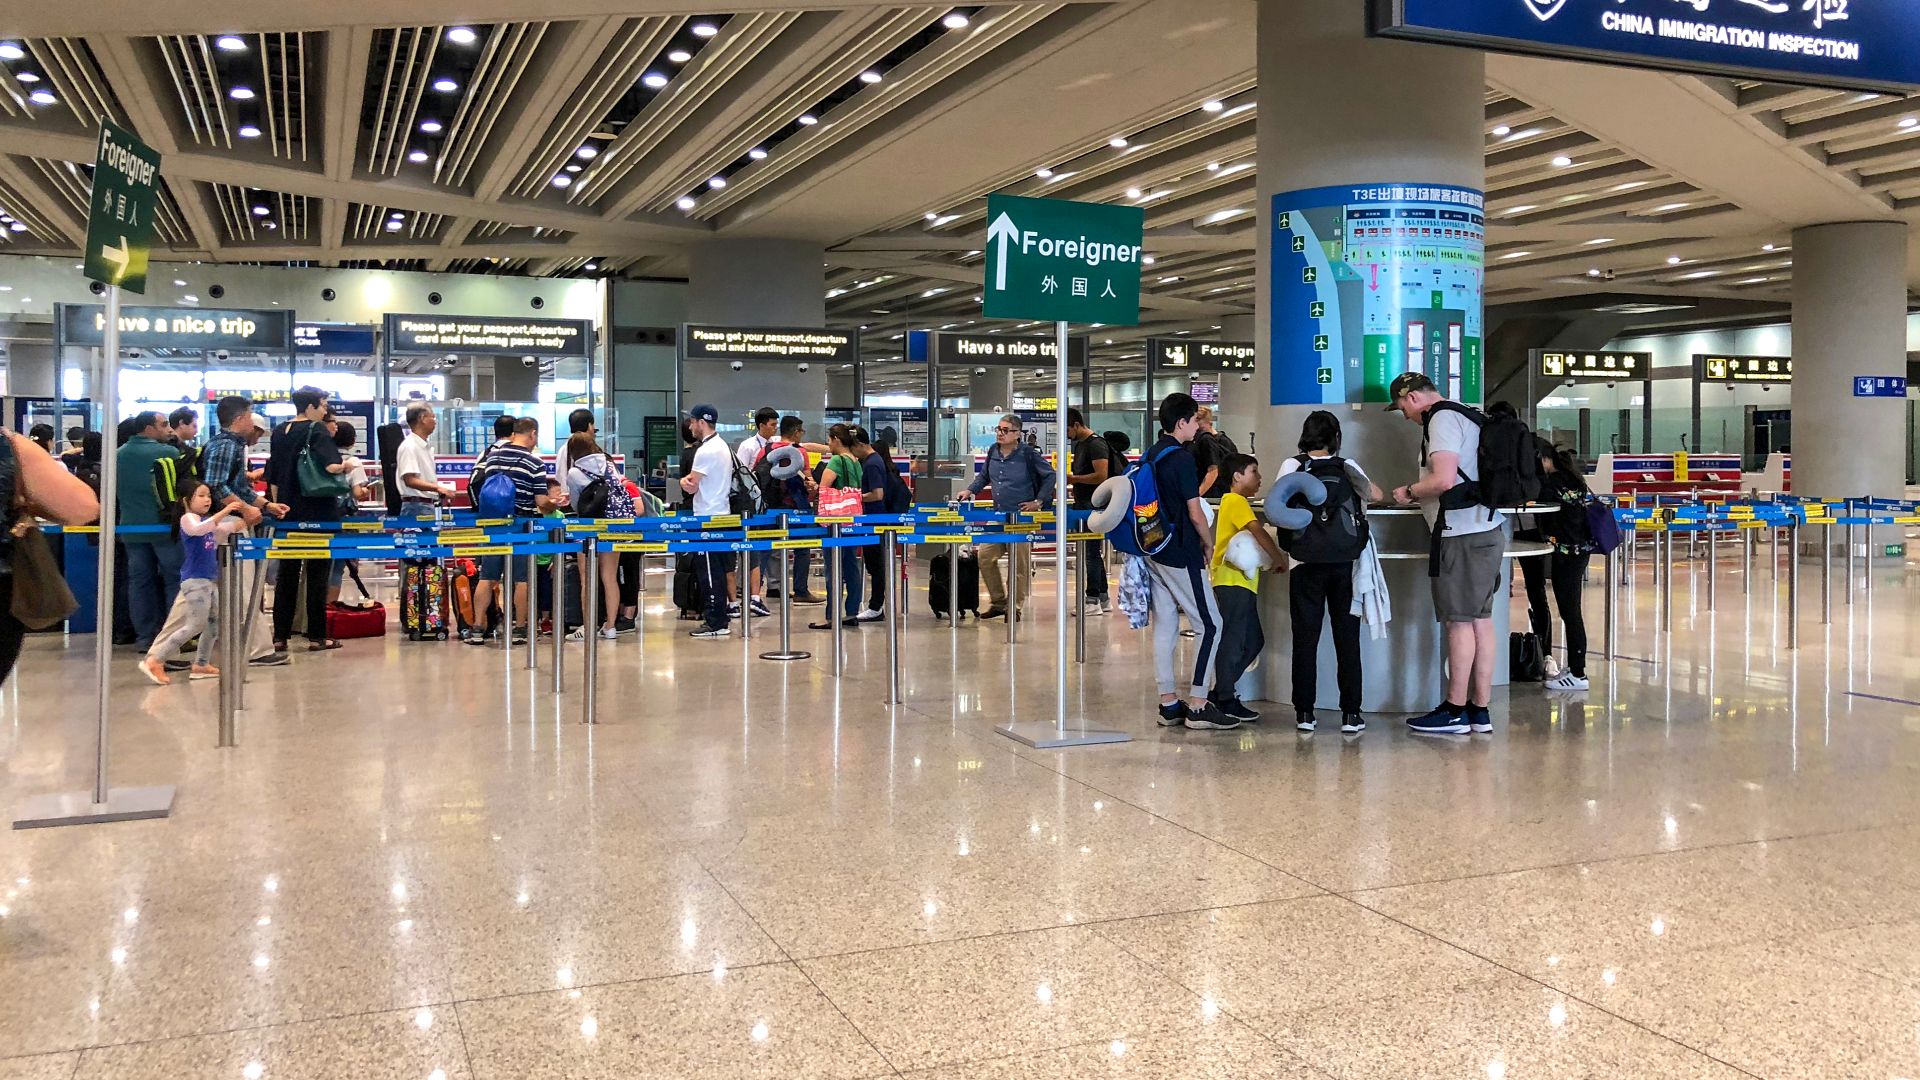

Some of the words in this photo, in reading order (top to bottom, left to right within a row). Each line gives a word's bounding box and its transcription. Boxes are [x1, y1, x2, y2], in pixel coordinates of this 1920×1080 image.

[1602, 11, 1654, 35] CHINA
[1659, 19, 1764, 48] IMMIGRATION
[1769, 32, 1858, 60] INSPECTION
[101, 129, 155, 186] Foreigner
[104, 188, 137, 226] 外国人
[1023, 231, 1141, 265] Foreigner
[1042, 275, 1116, 298] 外国人
[155, 318, 167, 332] a
[172, 316, 216, 333] nice
[221, 317, 255, 337] trip
[401, 321, 436, 331] Please
[438, 323, 456, 333] get
[457, 324, 481, 334] your
[694, 331, 725, 340] Please
[727, 332, 742, 341] get
[743, 333, 764, 342] your
[415, 334, 439, 343] card
[440, 335, 460, 344] and
[463, 335, 508, 347] boarding
[511, 337, 534, 347] pass
[536, 337, 565, 348] ready
[706, 343, 726, 351] card
[728, 343, 745, 352] and
[747, 343, 787, 354] boarding
[789, 346, 809, 354] pass
[812, 346, 837, 356] ready
[958, 340, 993, 354] Have
[996, 343, 1004, 354] a
[1008, 342, 1037, 355] nice
